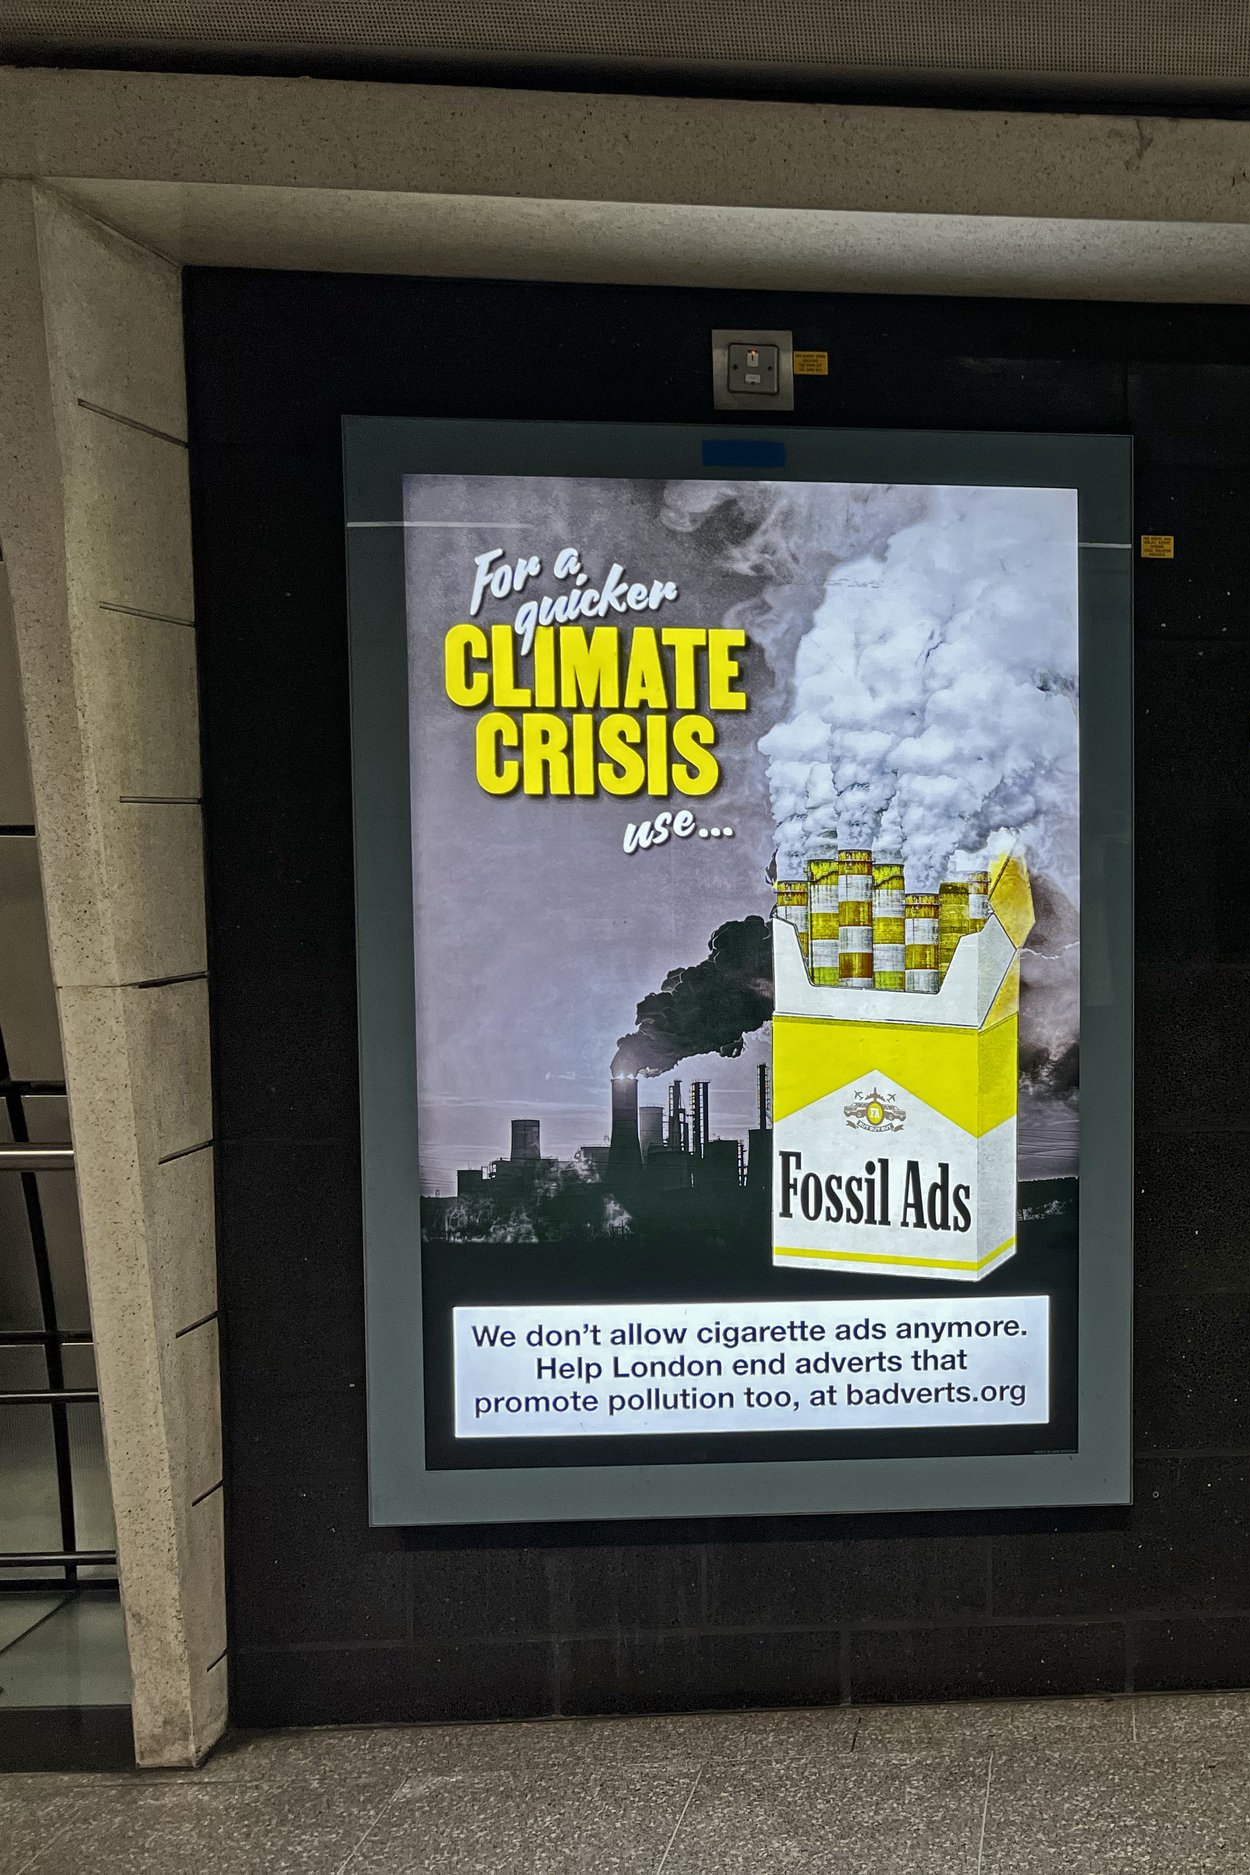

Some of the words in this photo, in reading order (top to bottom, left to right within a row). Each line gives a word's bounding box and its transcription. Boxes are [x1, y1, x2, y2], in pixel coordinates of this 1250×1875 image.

[470, 548, 541, 616] For
[554, 547, 582, 579] a
[514, 562, 678, 656] quicker
[444, 623, 747, 710] CLIMATE
[475, 711, 719, 796] CRISIS
[623, 809, 734, 854] use...
[778, 1150, 891, 1227] Fossil
[900, 1159, 972, 1233] Ads
[471, 1325, 516, 1348] We
[526, 1323, 602, 1347] don’t
[610, 1322, 688, 1346] allow
[696, 1320, 826, 1349] cigarette
[835, 1317, 887, 1341] ads
[895, 1317, 1028, 1344] anymore.
[536, 1356, 603, 1384] Help
[613, 1354, 722, 1378] London
[732, 1352, 785, 1376] end
[795, 1351, 903, 1375] adverts
[910, 1348, 968, 1371] that
[475, 1390, 599, 1419] promote
[609, 1387, 734, 1416] pollution
[743, 1387, 800, 1412] too,
[809, 1385, 838, 1407] at
[847, 1381, 1027, 1407] badverts.org
